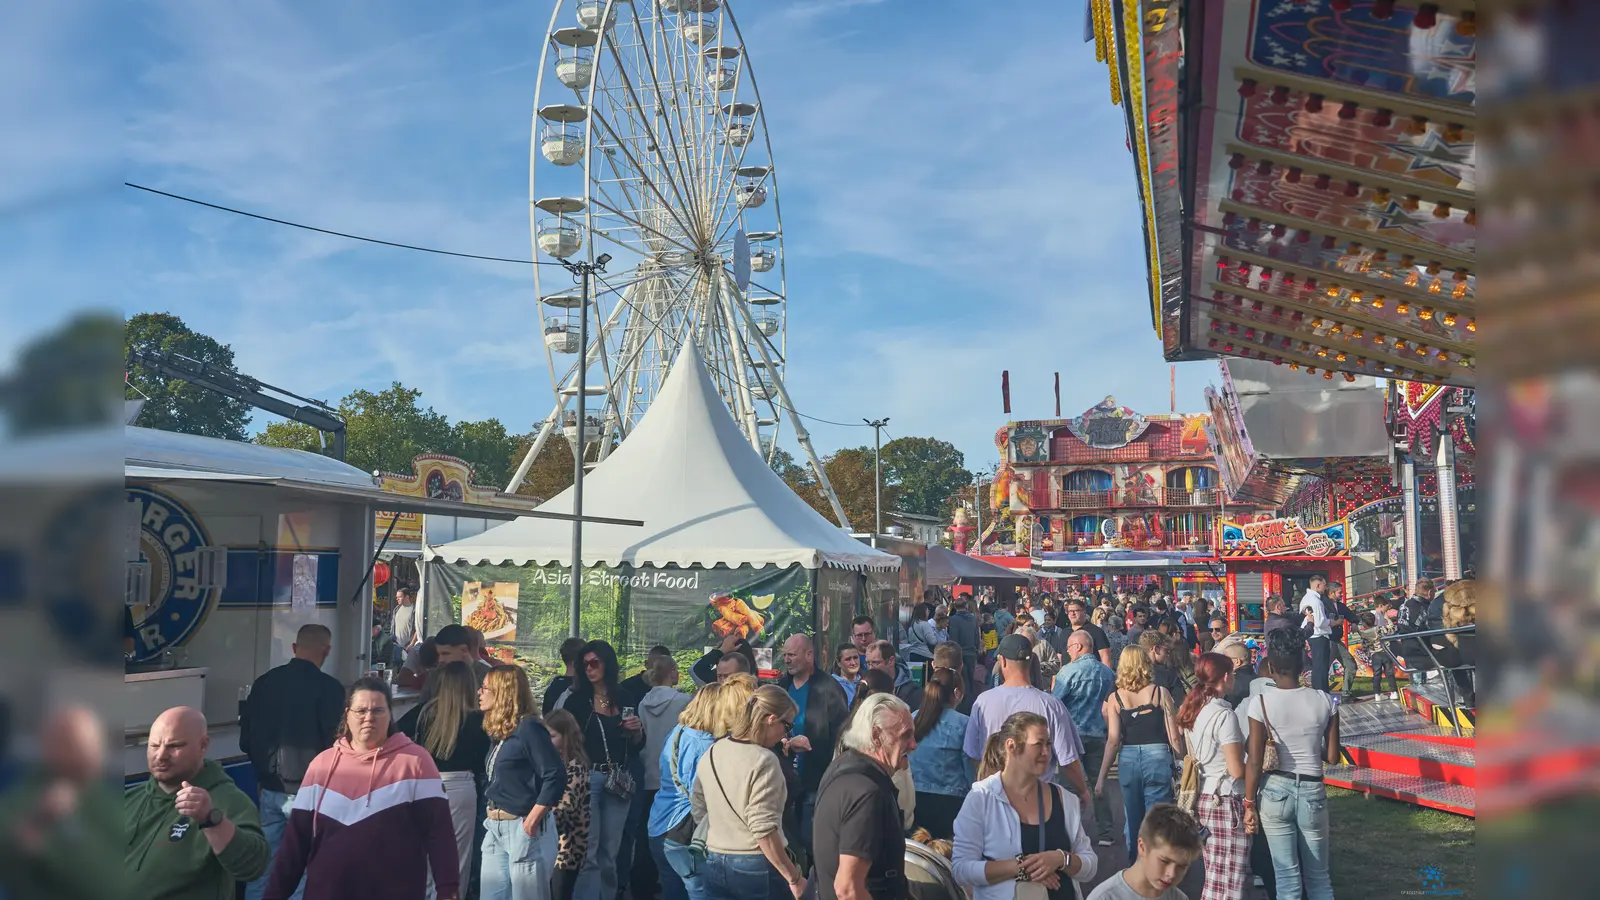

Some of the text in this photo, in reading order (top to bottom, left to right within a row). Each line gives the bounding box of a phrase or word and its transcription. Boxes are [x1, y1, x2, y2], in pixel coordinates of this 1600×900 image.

[1245, 521, 1287, 540] BREAK
[126, 493, 201, 600] RGER
[1257, 531, 1308, 551] DANCER
[589, 570, 650, 589] Street
[653, 571, 699, 589] Food
